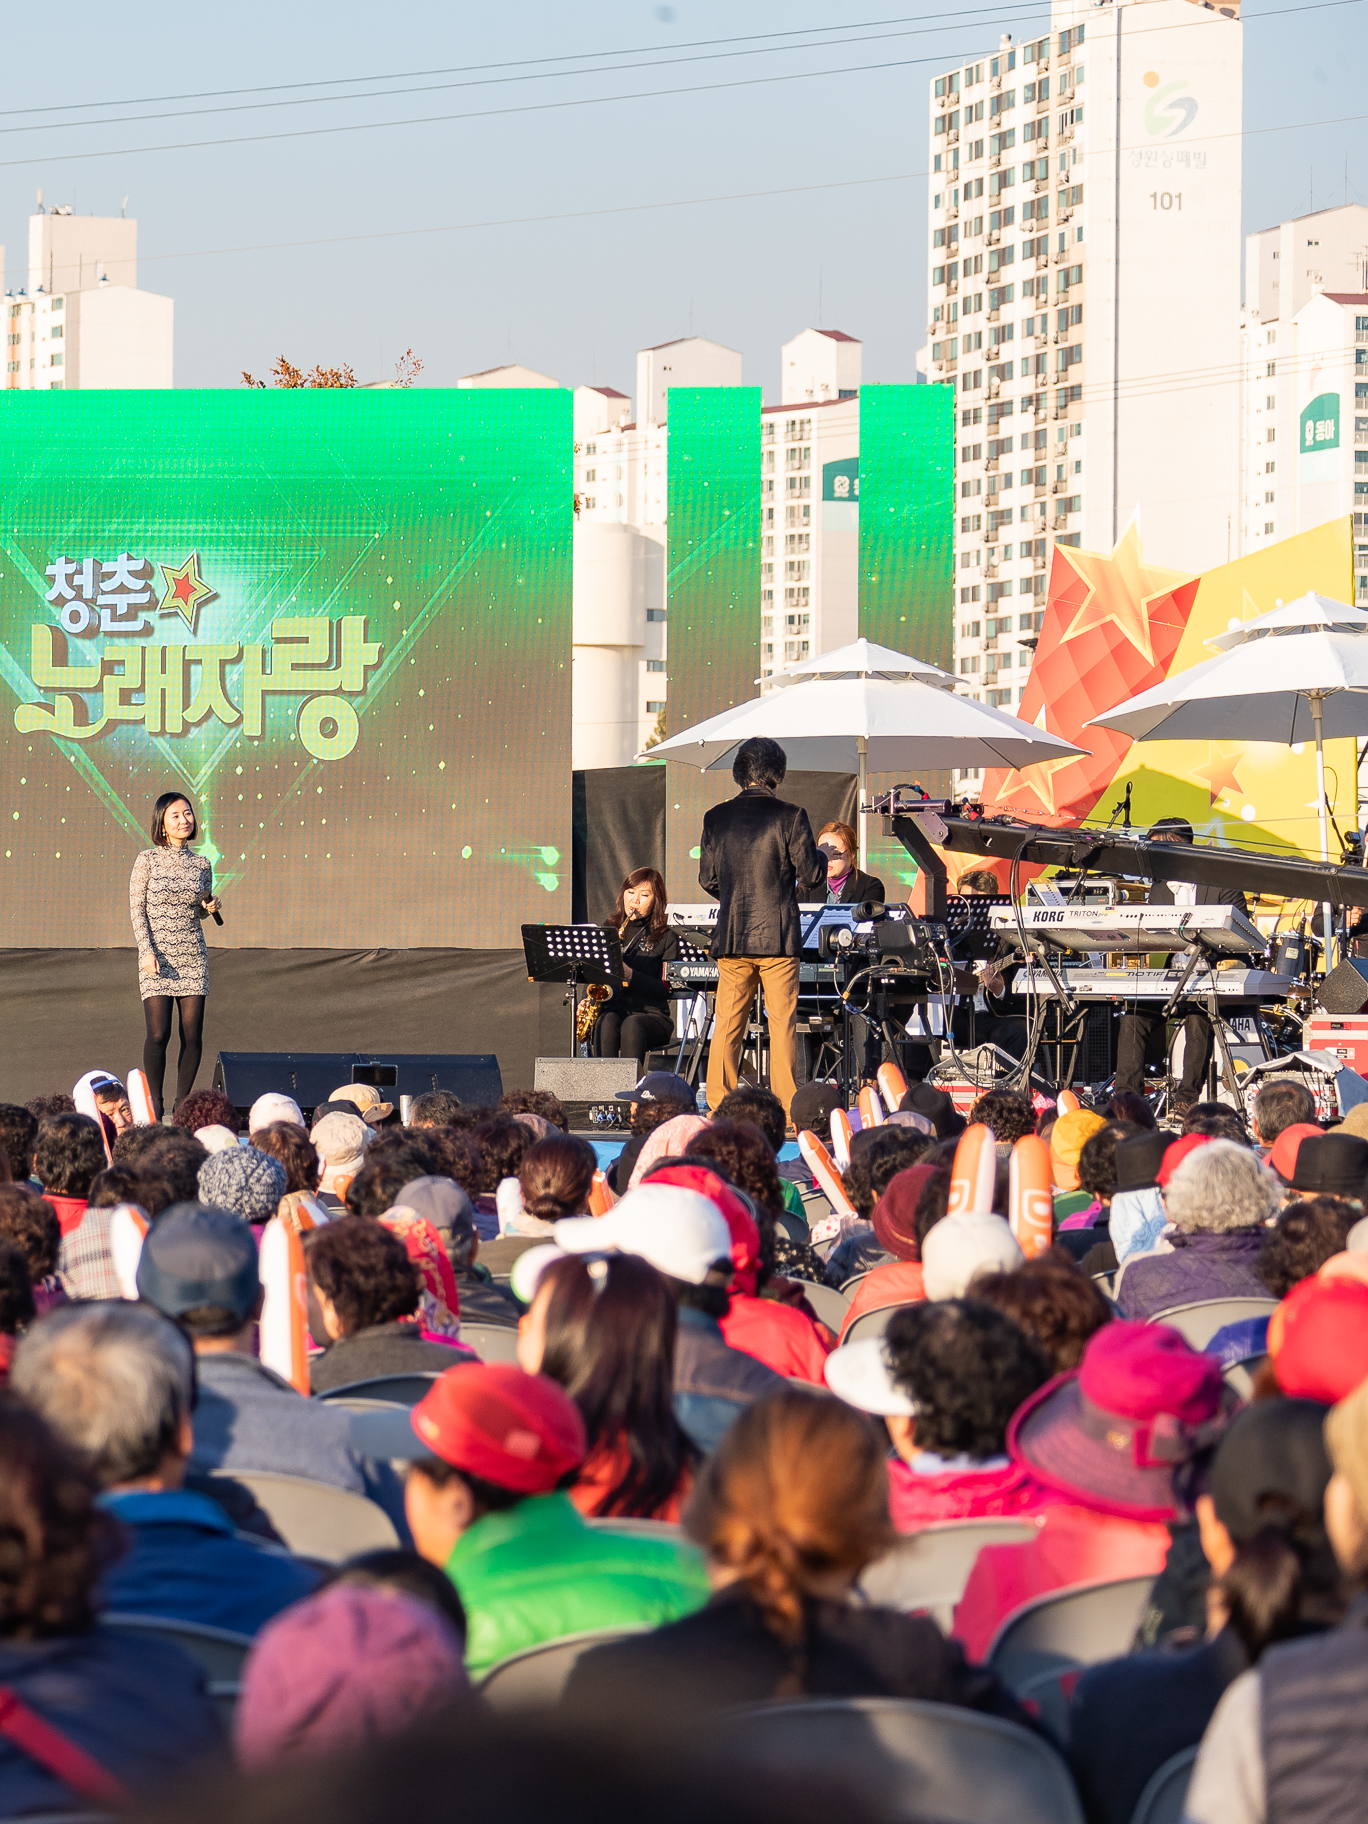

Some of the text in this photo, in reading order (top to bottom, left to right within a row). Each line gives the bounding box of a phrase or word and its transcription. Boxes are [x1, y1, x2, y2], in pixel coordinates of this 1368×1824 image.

[1128, 150, 1207, 169] 성원상떼빌
[1149, 191, 1182, 211] 101
[1315, 419, 1335, 441] 동아
[44, 551, 153, 635] 청춘
[13, 614, 384, 761] 노래자랑
[1033, 911, 1065, 923] KORG
[689, 966, 719, 978] YAMAHA
